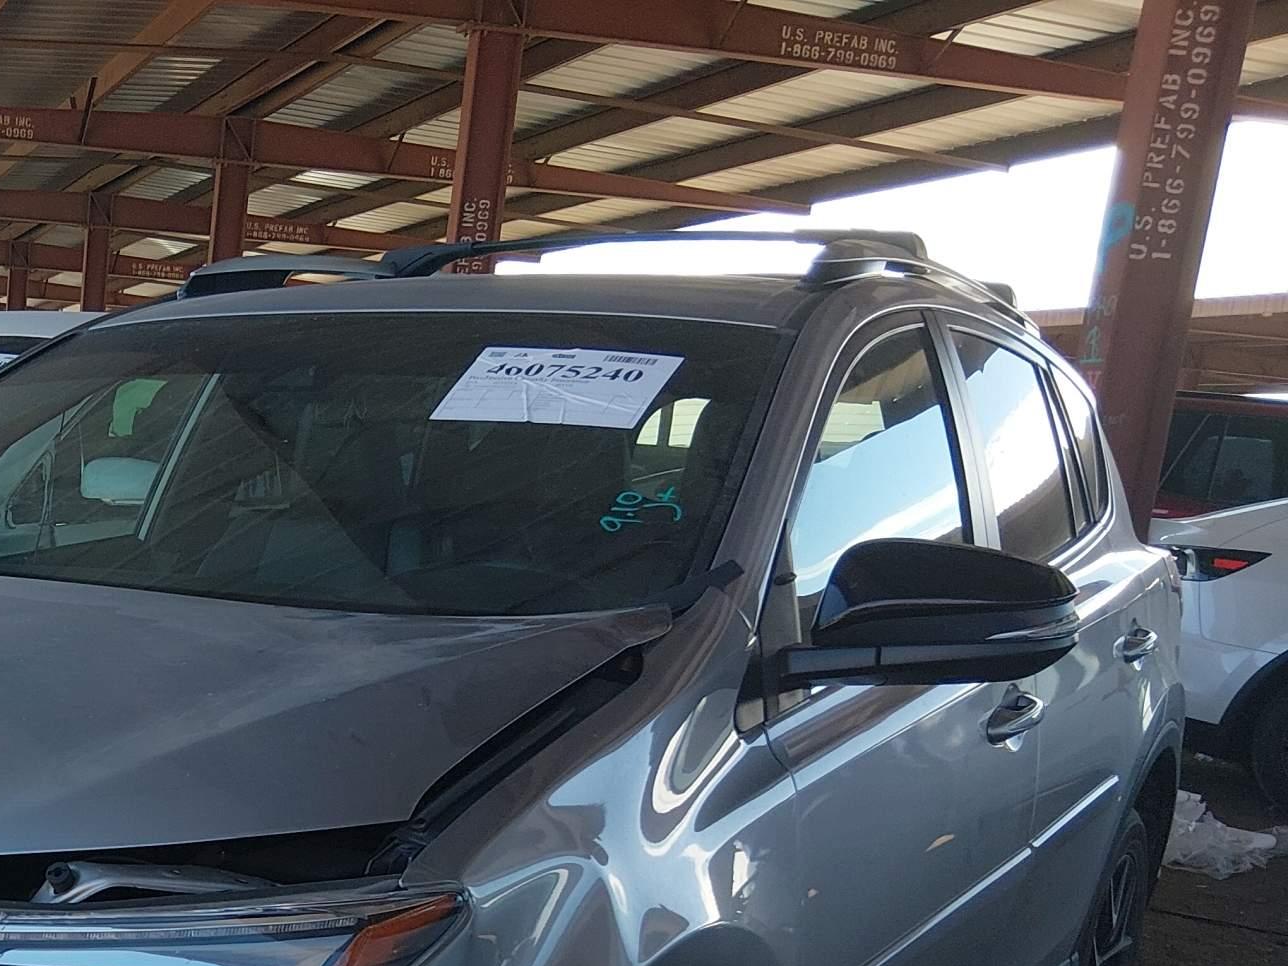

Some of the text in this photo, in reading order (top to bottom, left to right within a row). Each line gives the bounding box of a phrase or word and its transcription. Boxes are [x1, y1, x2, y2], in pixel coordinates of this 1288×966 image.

[782, 25, 899, 54] U.S. PREFAB INC.
[780, 42, 897, 69] 1-866-799-0969
[1129, 1, 1197, 260] U.S. PREFAB INC.
[1152, 5, 1220, 259] 1-866-799-0969
[431, 156, 449, 167] U.S.
[461, 197, 477, 228] INC.
